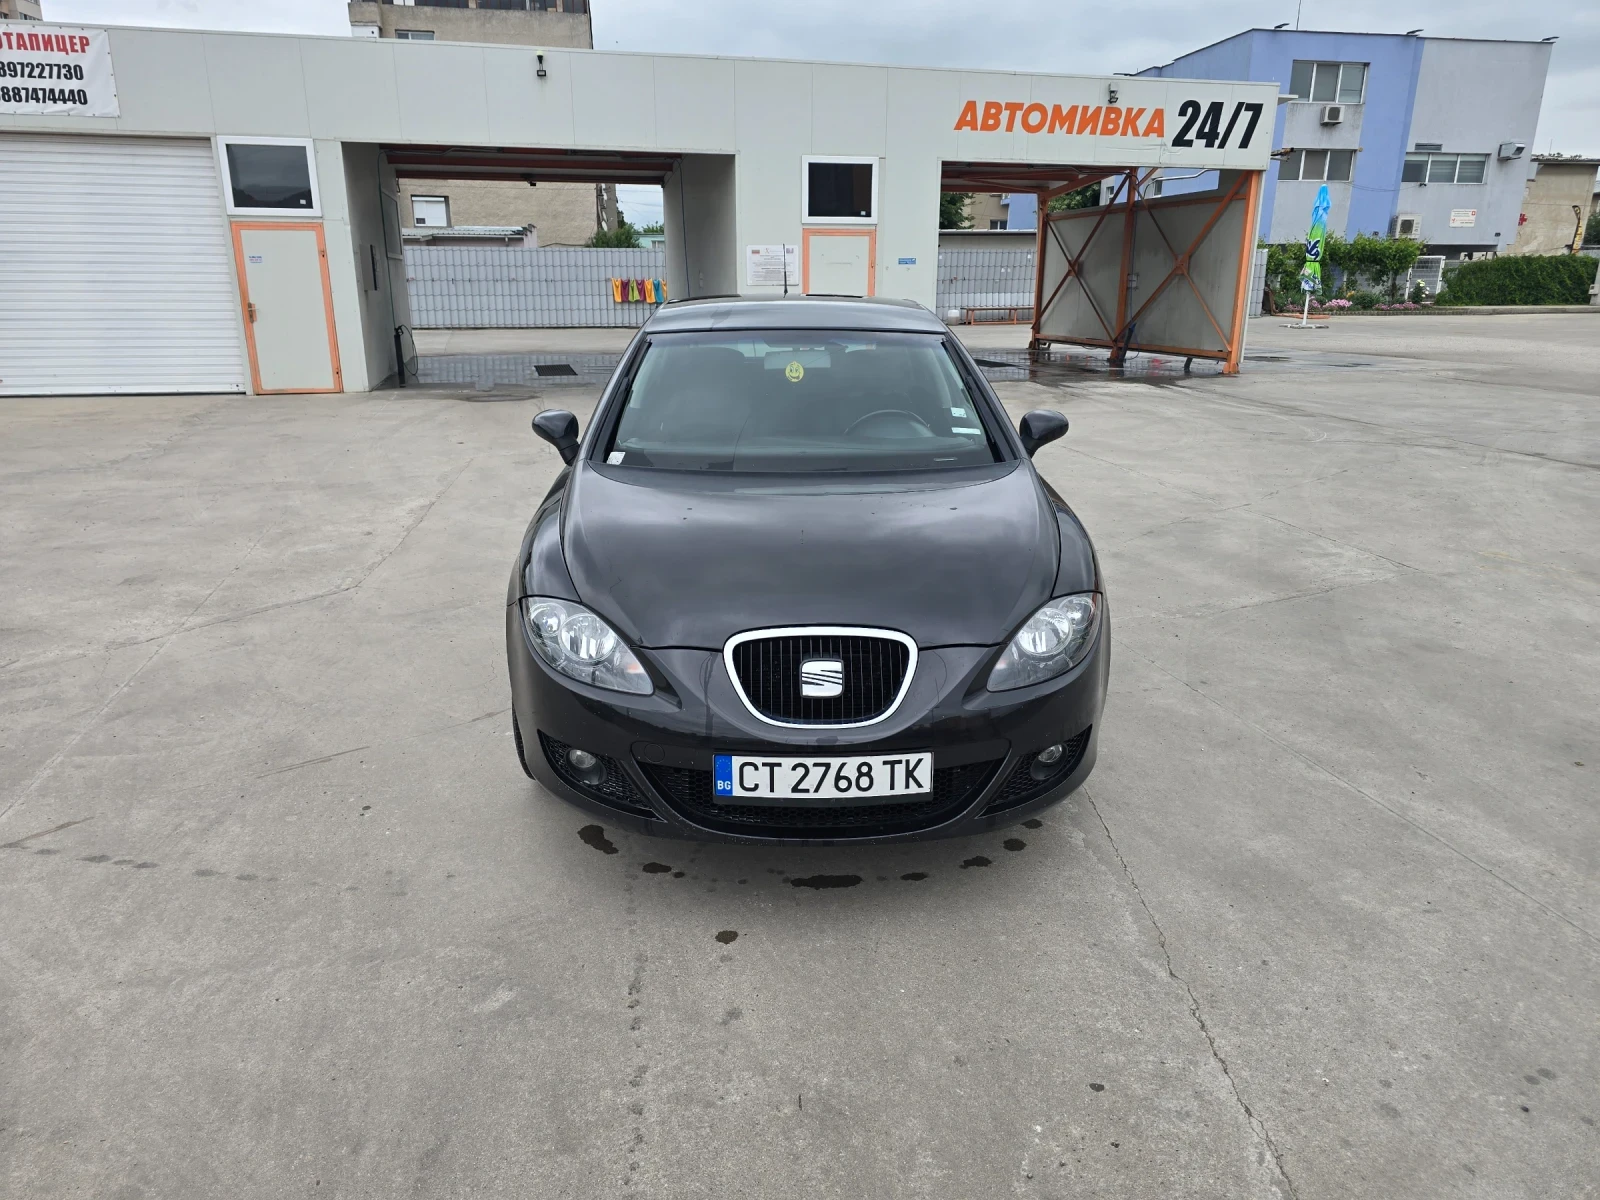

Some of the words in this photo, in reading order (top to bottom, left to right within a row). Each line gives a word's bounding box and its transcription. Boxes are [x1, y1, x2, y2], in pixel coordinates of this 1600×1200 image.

[0, 32, 90, 55] ТАПИЦЕР
[0, 61, 84, 81] 897227730
[953, 100, 1165, 138] АВТОМИВКА
[1171, 99, 1264, 149] 24/7
[717, 780, 731, 790] BG
[738, 761, 782, 793] CT
[790, 761, 874, 793] 2768
[882, 758, 924, 791] TK
